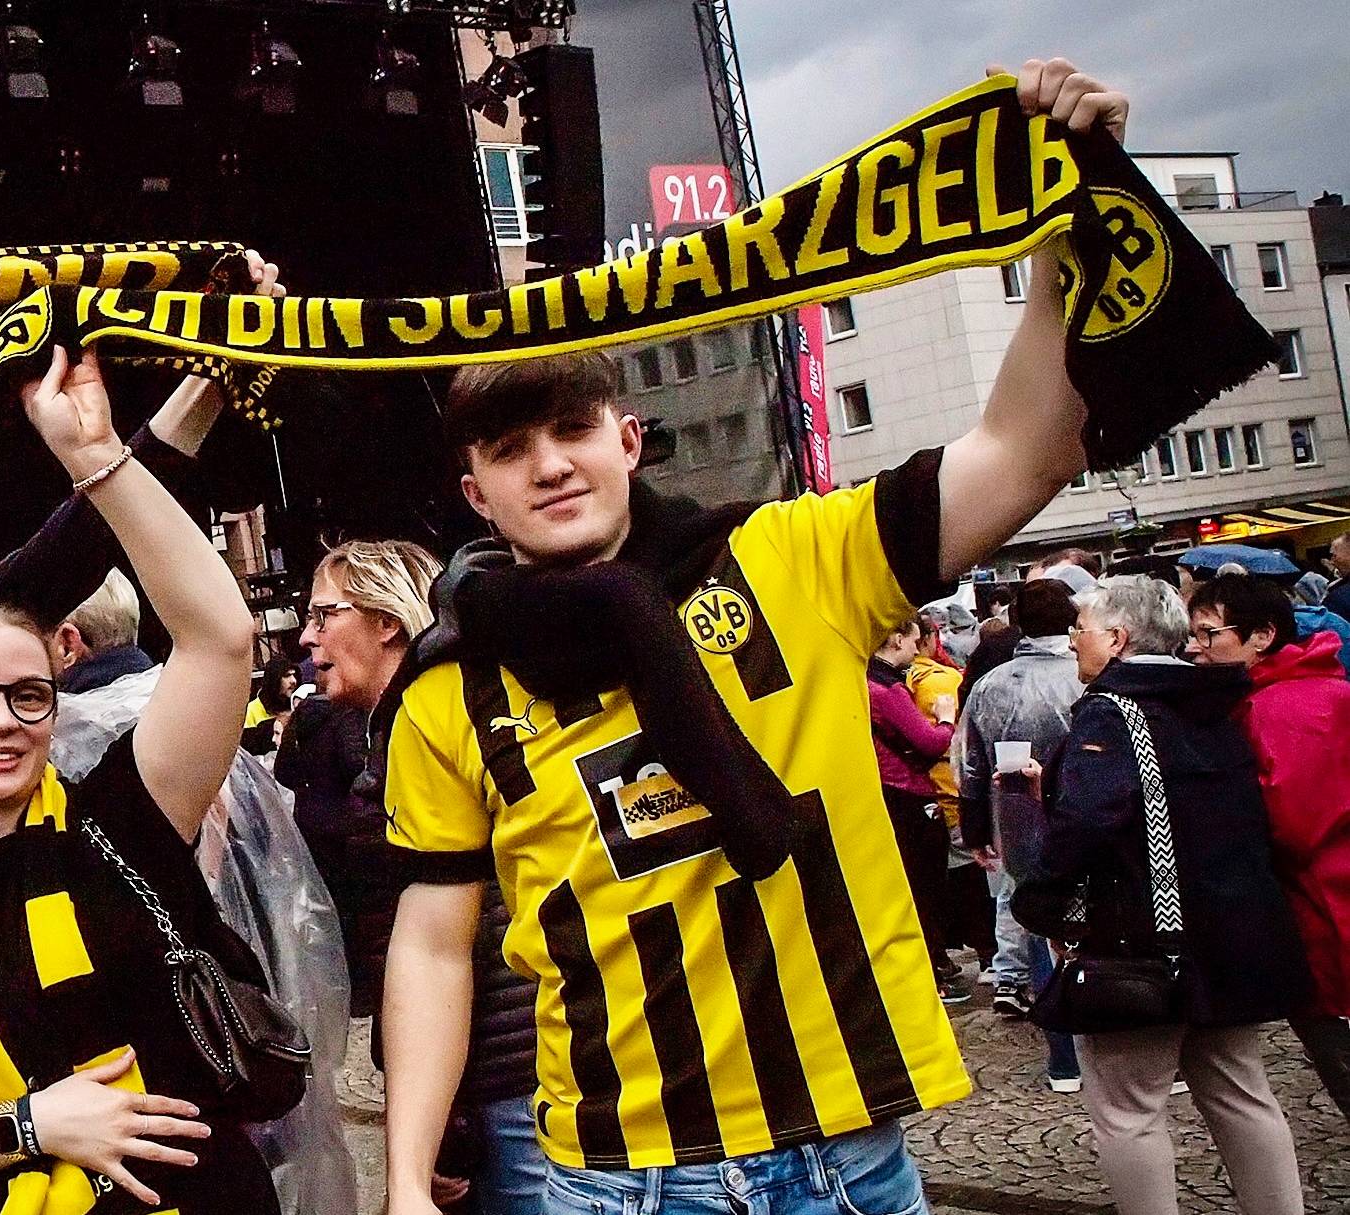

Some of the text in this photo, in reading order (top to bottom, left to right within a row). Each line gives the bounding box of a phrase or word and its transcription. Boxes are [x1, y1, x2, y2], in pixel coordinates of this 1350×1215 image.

[664, 175, 730, 221] 91.2
[692, 594, 746, 641] BVB
[716, 630, 737, 648] 09
